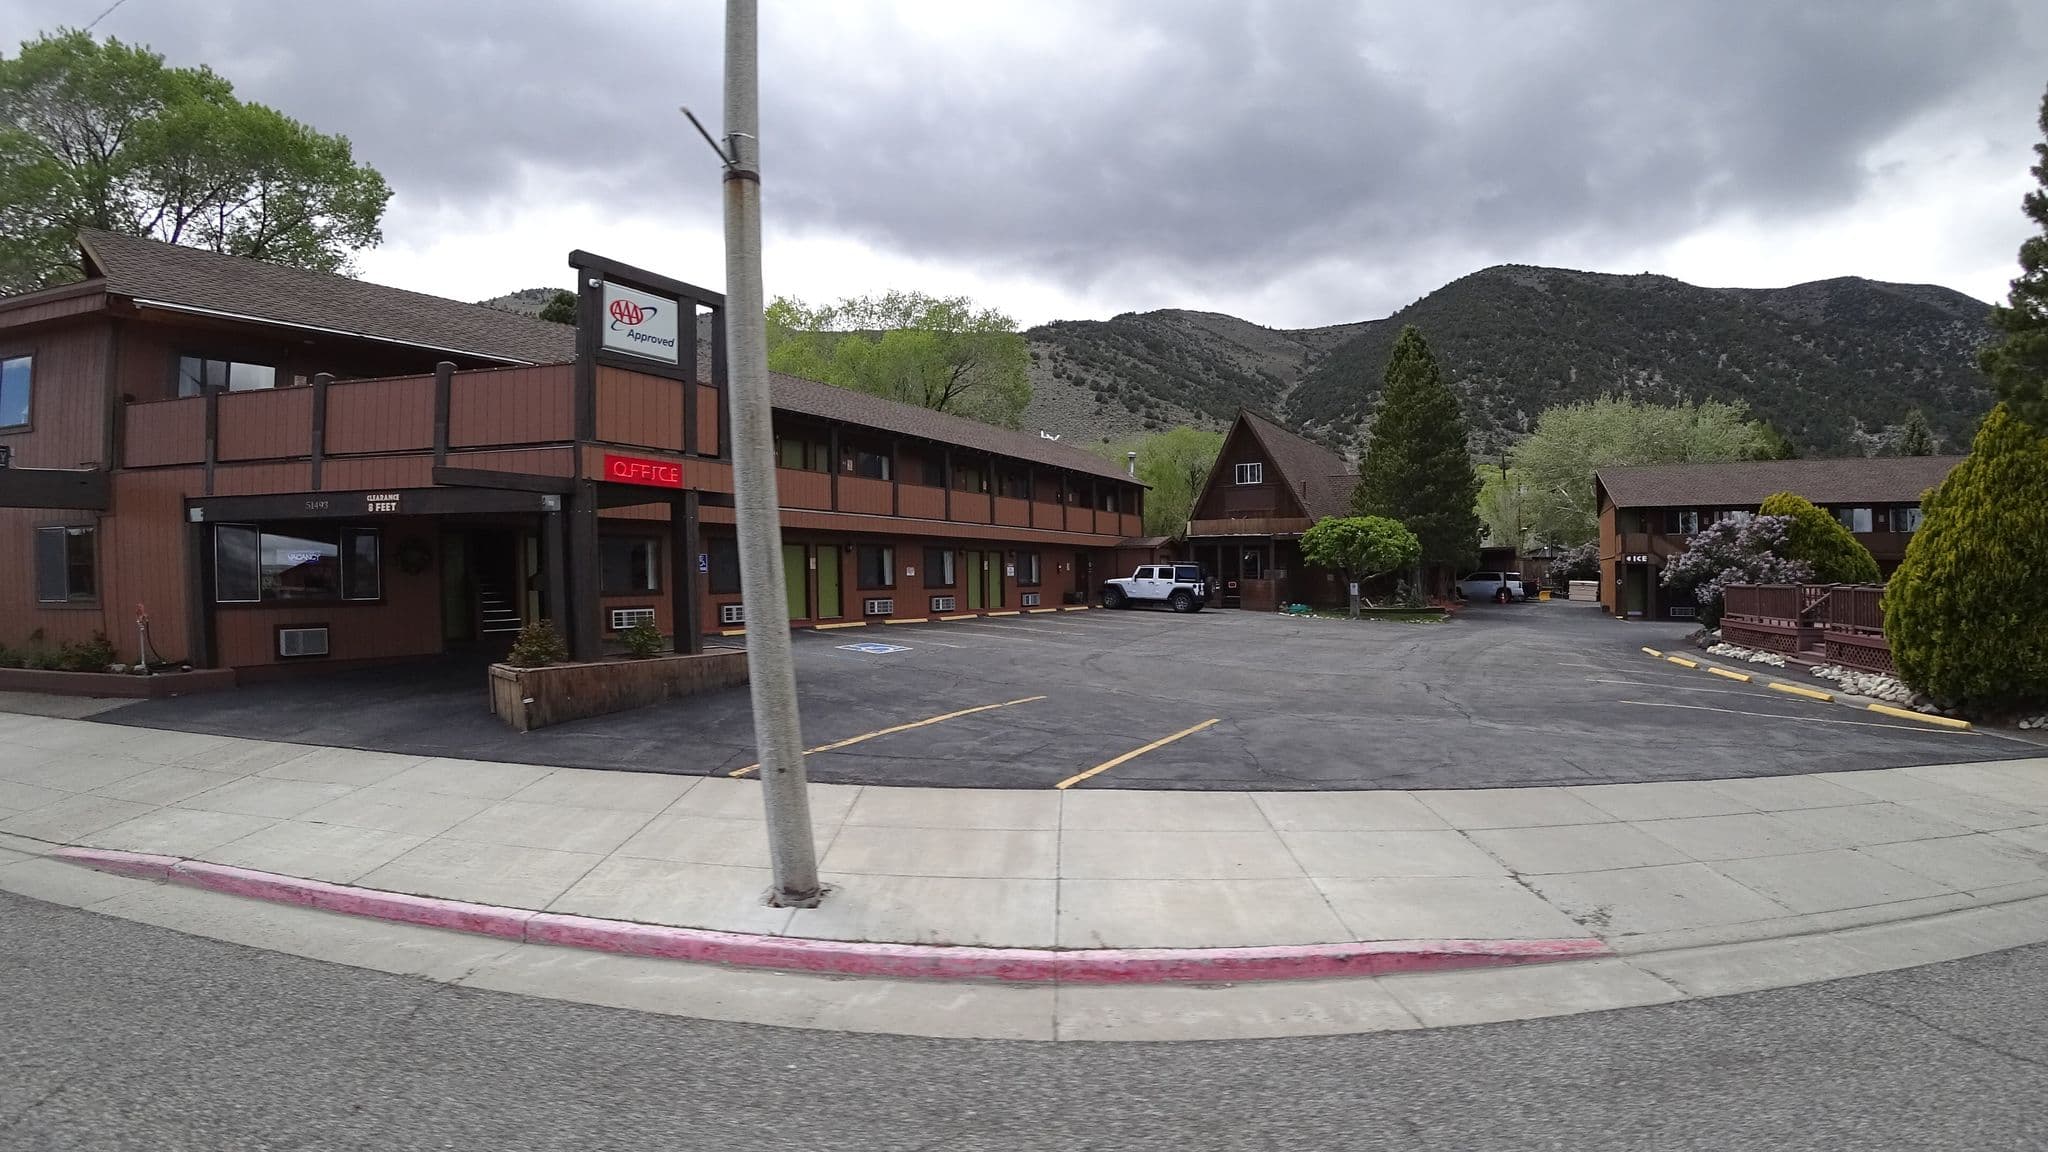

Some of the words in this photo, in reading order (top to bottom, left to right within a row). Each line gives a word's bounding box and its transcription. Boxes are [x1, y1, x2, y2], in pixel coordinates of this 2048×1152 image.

[613, 300, 641, 325] AAA
[627, 329, 675, 347] Approved
[613, 461, 679, 482] OFFICE
[366, 494, 400, 502] CLEARANCE
[305, 501, 329, 511] 51493
[368, 503, 374, 512] 8
[375, 502, 397, 512] FEET
[287, 552, 321, 562] VACANCY
